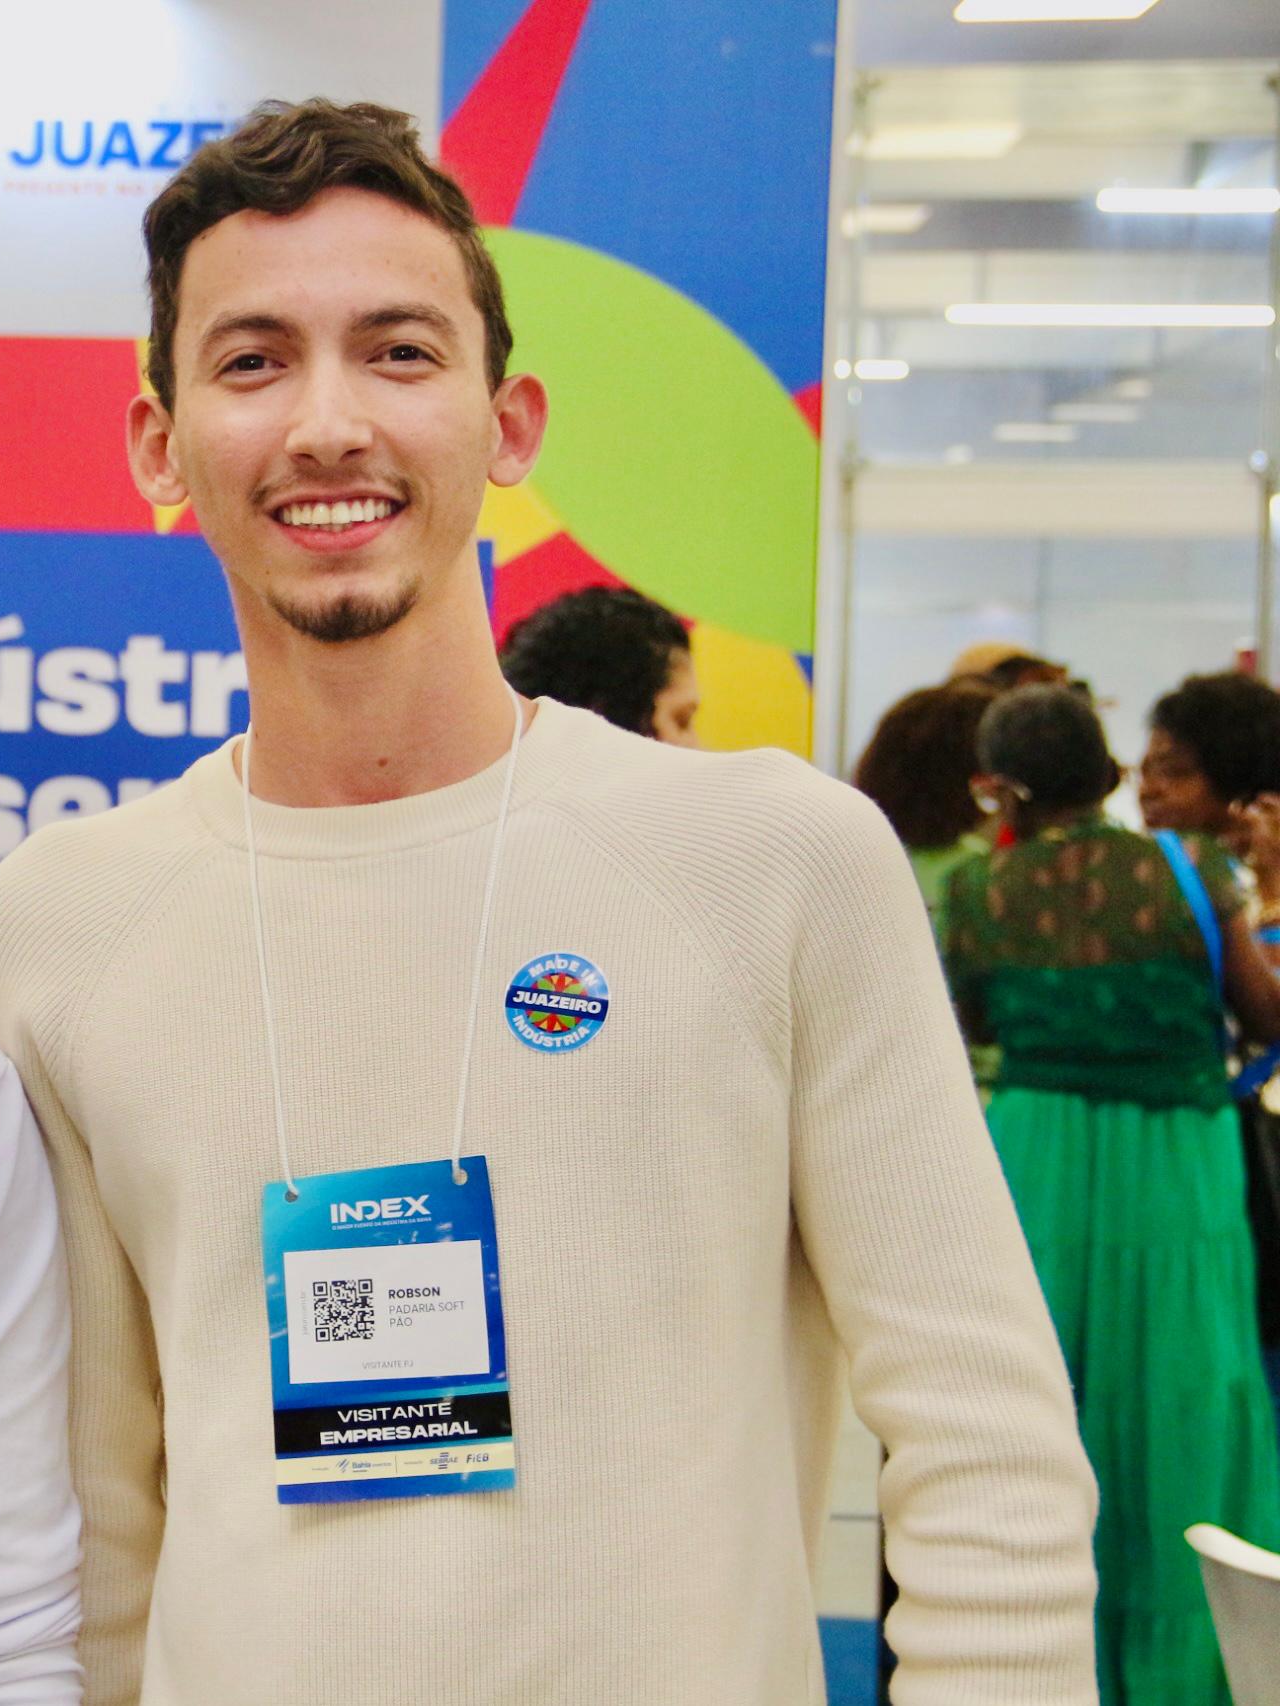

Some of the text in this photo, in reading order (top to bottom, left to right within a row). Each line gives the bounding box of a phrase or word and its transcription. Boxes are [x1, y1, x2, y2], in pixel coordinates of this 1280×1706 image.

[528, 959, 599, 986] MADE IN
[513, 991, 602, 1014] JUAZEIRO
[513, 1015, 590, 1047] INDÚSTRIA
[330, 1194, 432, 1223] INDEX
[388, 1287, 441, 1299] ROBSON
[389, 1301, 465, 1315] PADARIA SOFT
[337, 1402, 452, 1423] VISITANTE
[320, 1421, 478, 1446] EMPRESARIAL
